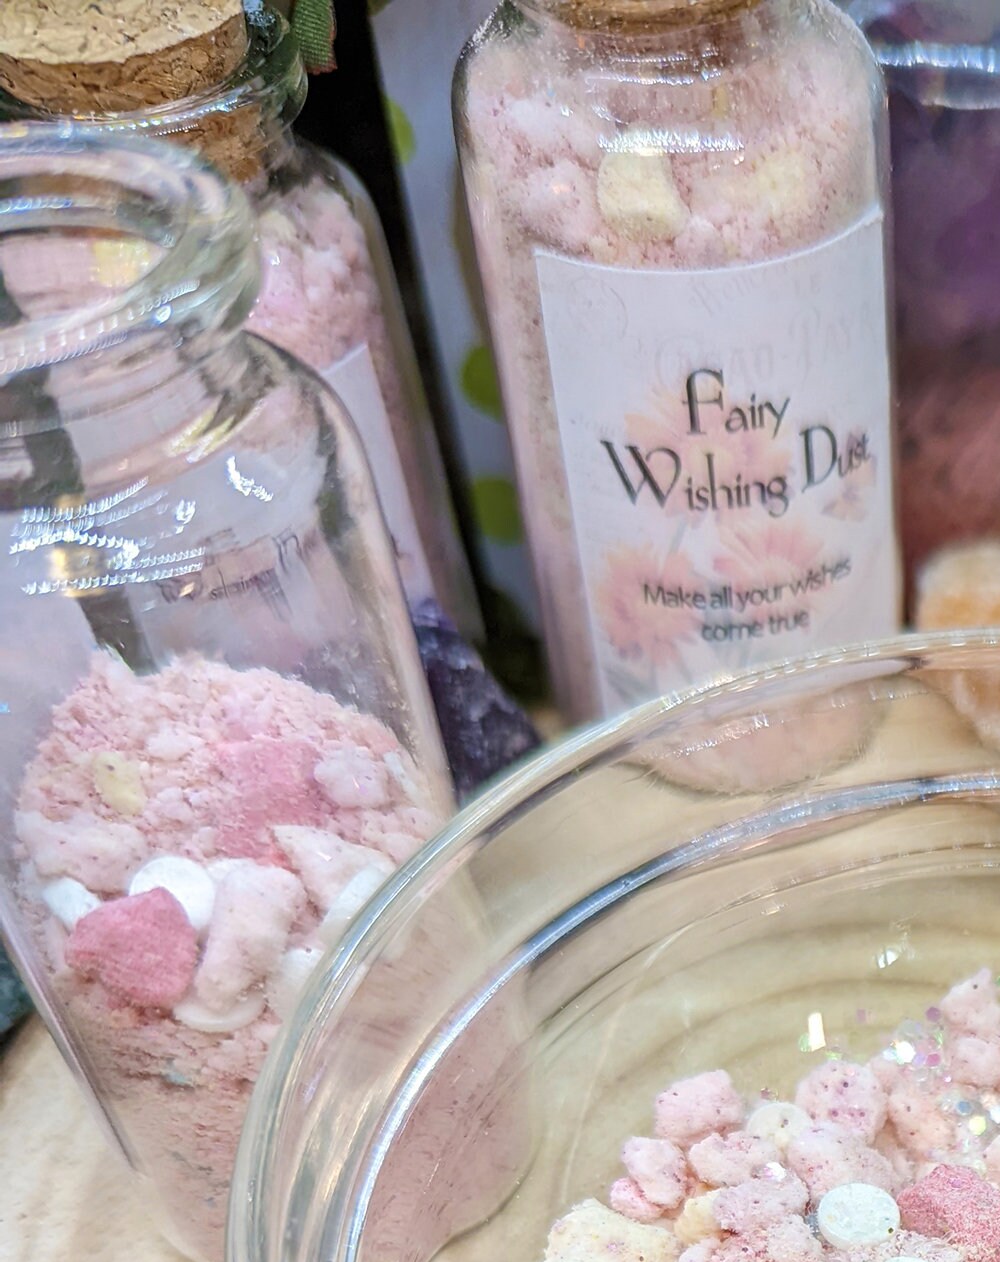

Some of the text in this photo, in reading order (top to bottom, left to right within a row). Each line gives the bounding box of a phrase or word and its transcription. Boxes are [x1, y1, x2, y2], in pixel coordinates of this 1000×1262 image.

[682, 368, 791, 438] Fairy
[600, 425, 872, 517] Wishing Dust
[643, 556, 852, 613] Make all your wishes
[701, 608, 810, 642] come true
